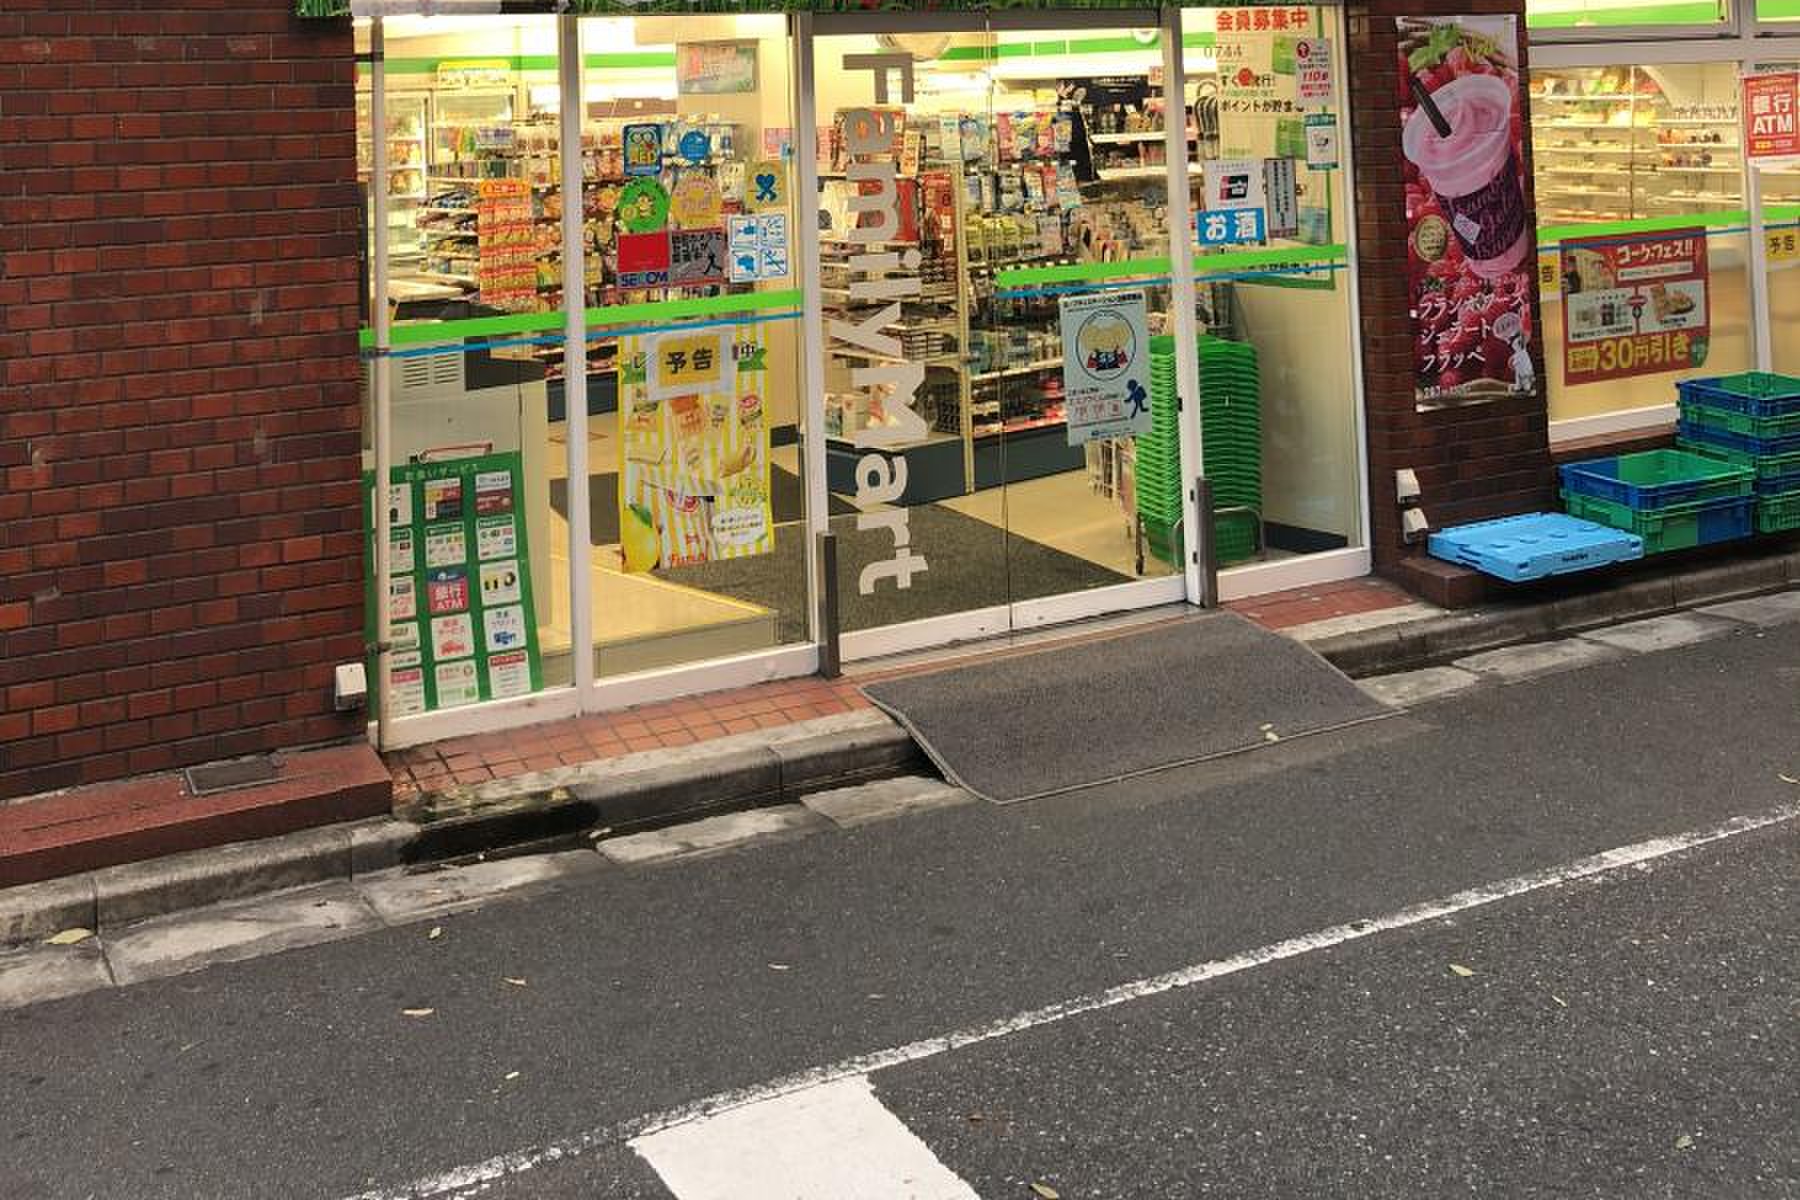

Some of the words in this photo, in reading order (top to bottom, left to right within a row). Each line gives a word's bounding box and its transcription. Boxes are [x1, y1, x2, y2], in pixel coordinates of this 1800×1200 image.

[1216, 7, 1309, 31] 会員募集中
[1752, 113, 1793, 135] ATM
[1205, 211, 1258, 241] お酒
[830, 52, 929, 596] FamilyMart
[665, 347, 714, 374] 予告
